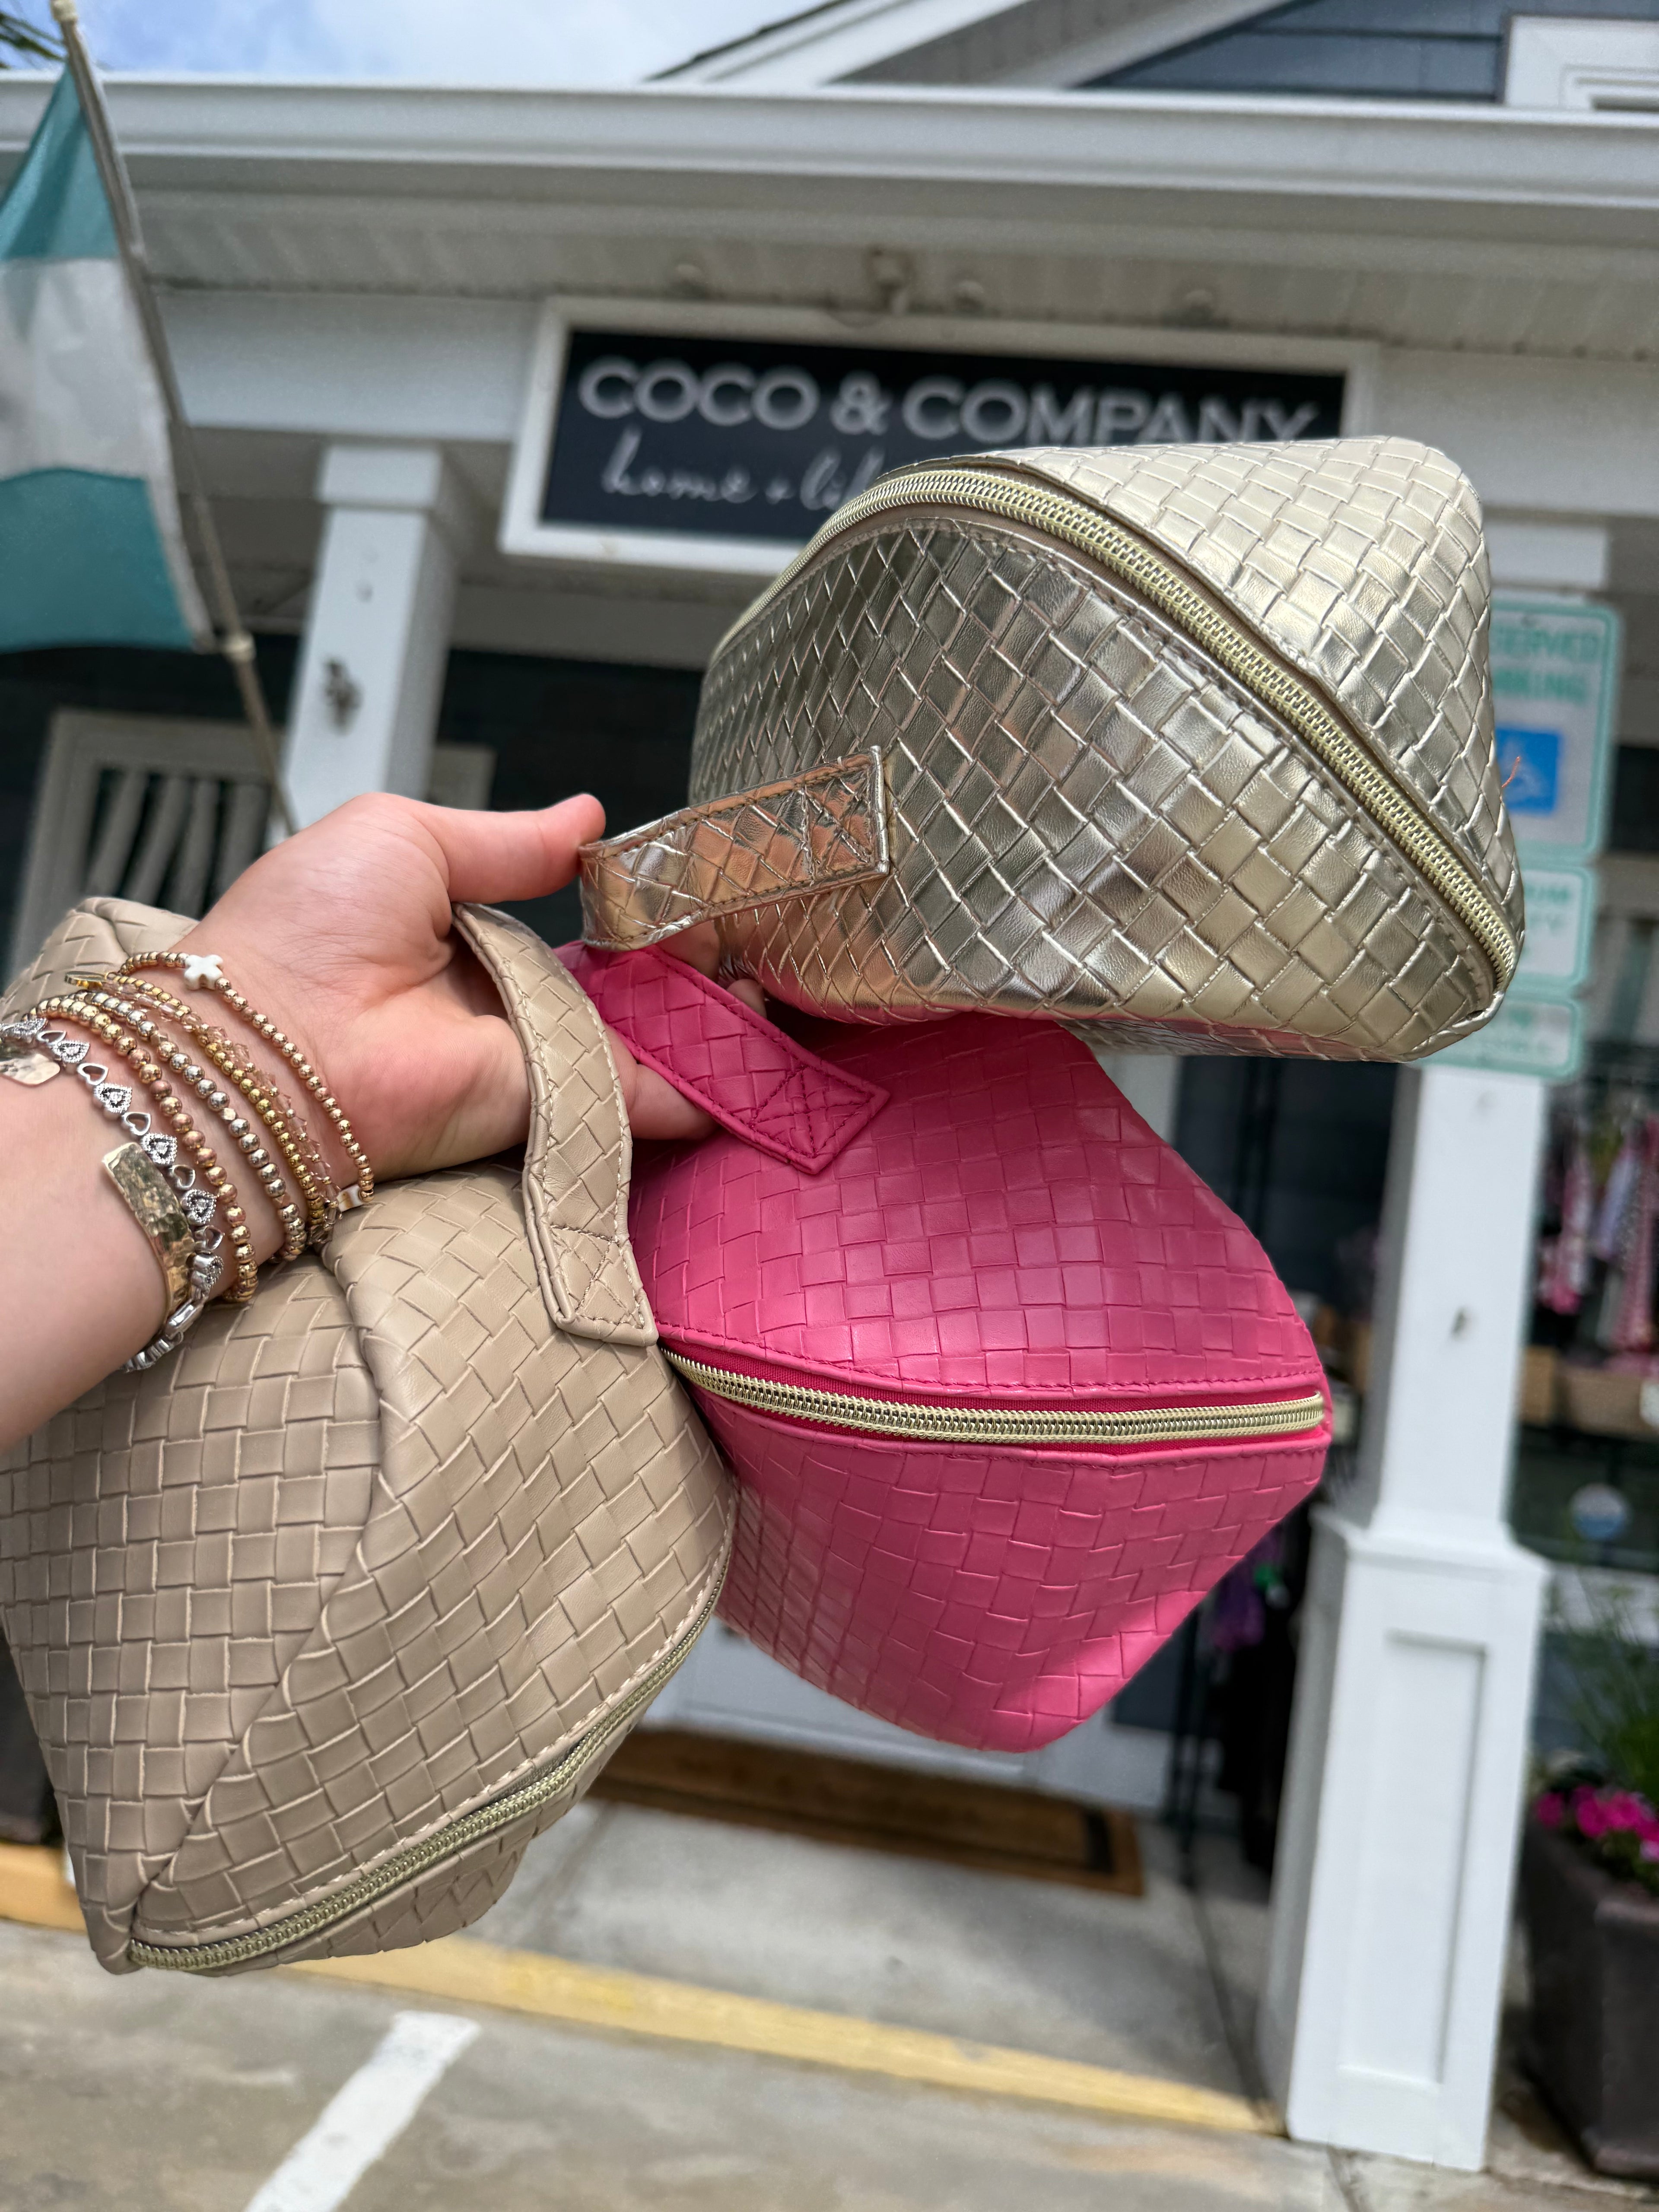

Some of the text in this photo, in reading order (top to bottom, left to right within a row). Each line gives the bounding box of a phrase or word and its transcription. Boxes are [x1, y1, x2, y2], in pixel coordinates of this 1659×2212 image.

[579, 357, 1319, 445] COCO & COMPANY
[603, 426, 755, 503] home
